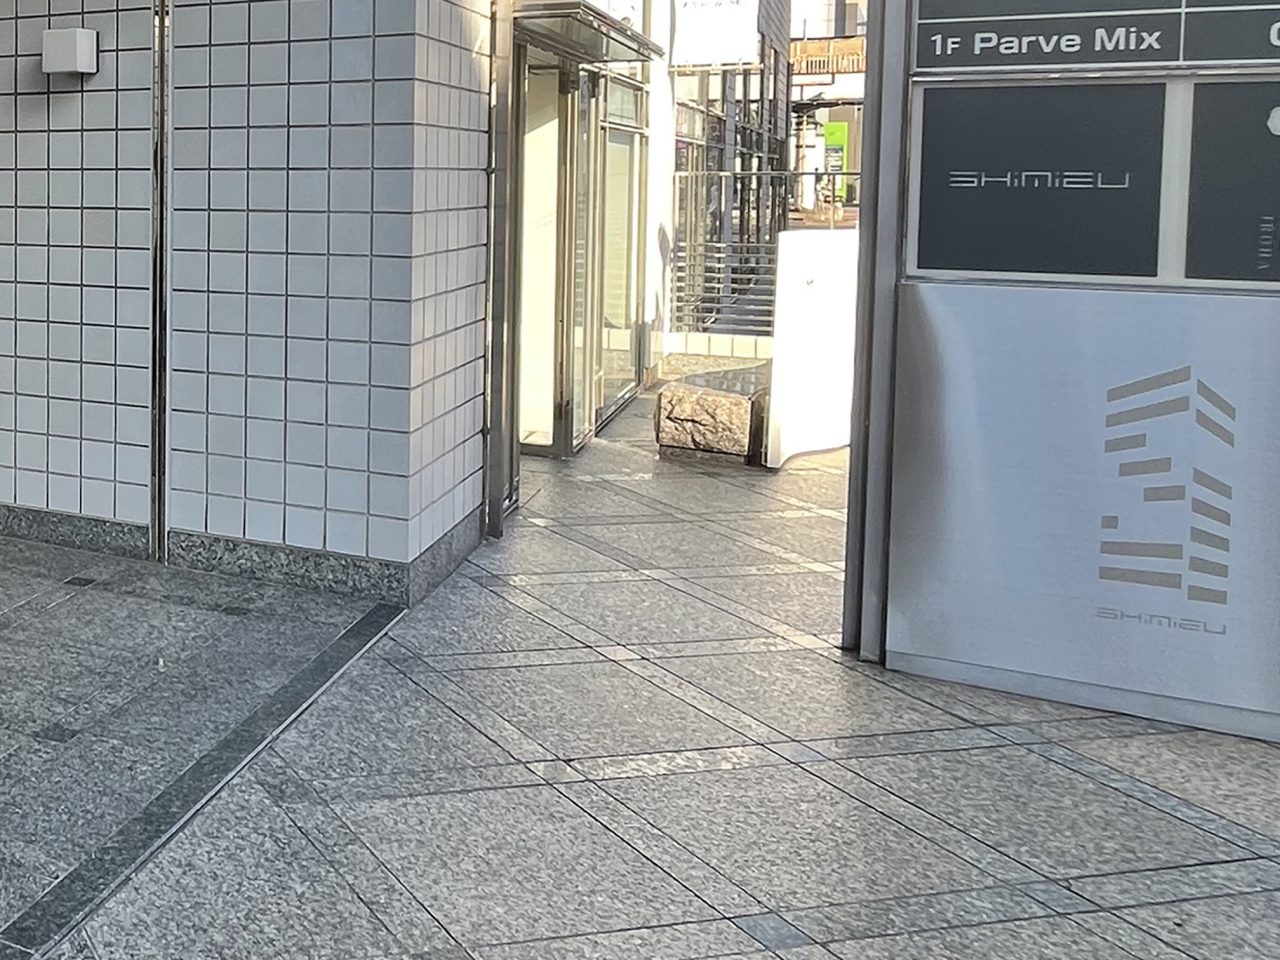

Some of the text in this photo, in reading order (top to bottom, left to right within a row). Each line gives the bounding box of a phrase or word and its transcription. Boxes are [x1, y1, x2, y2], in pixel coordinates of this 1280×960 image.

[931, 27, 1162, 55] 1F Parve Mix
